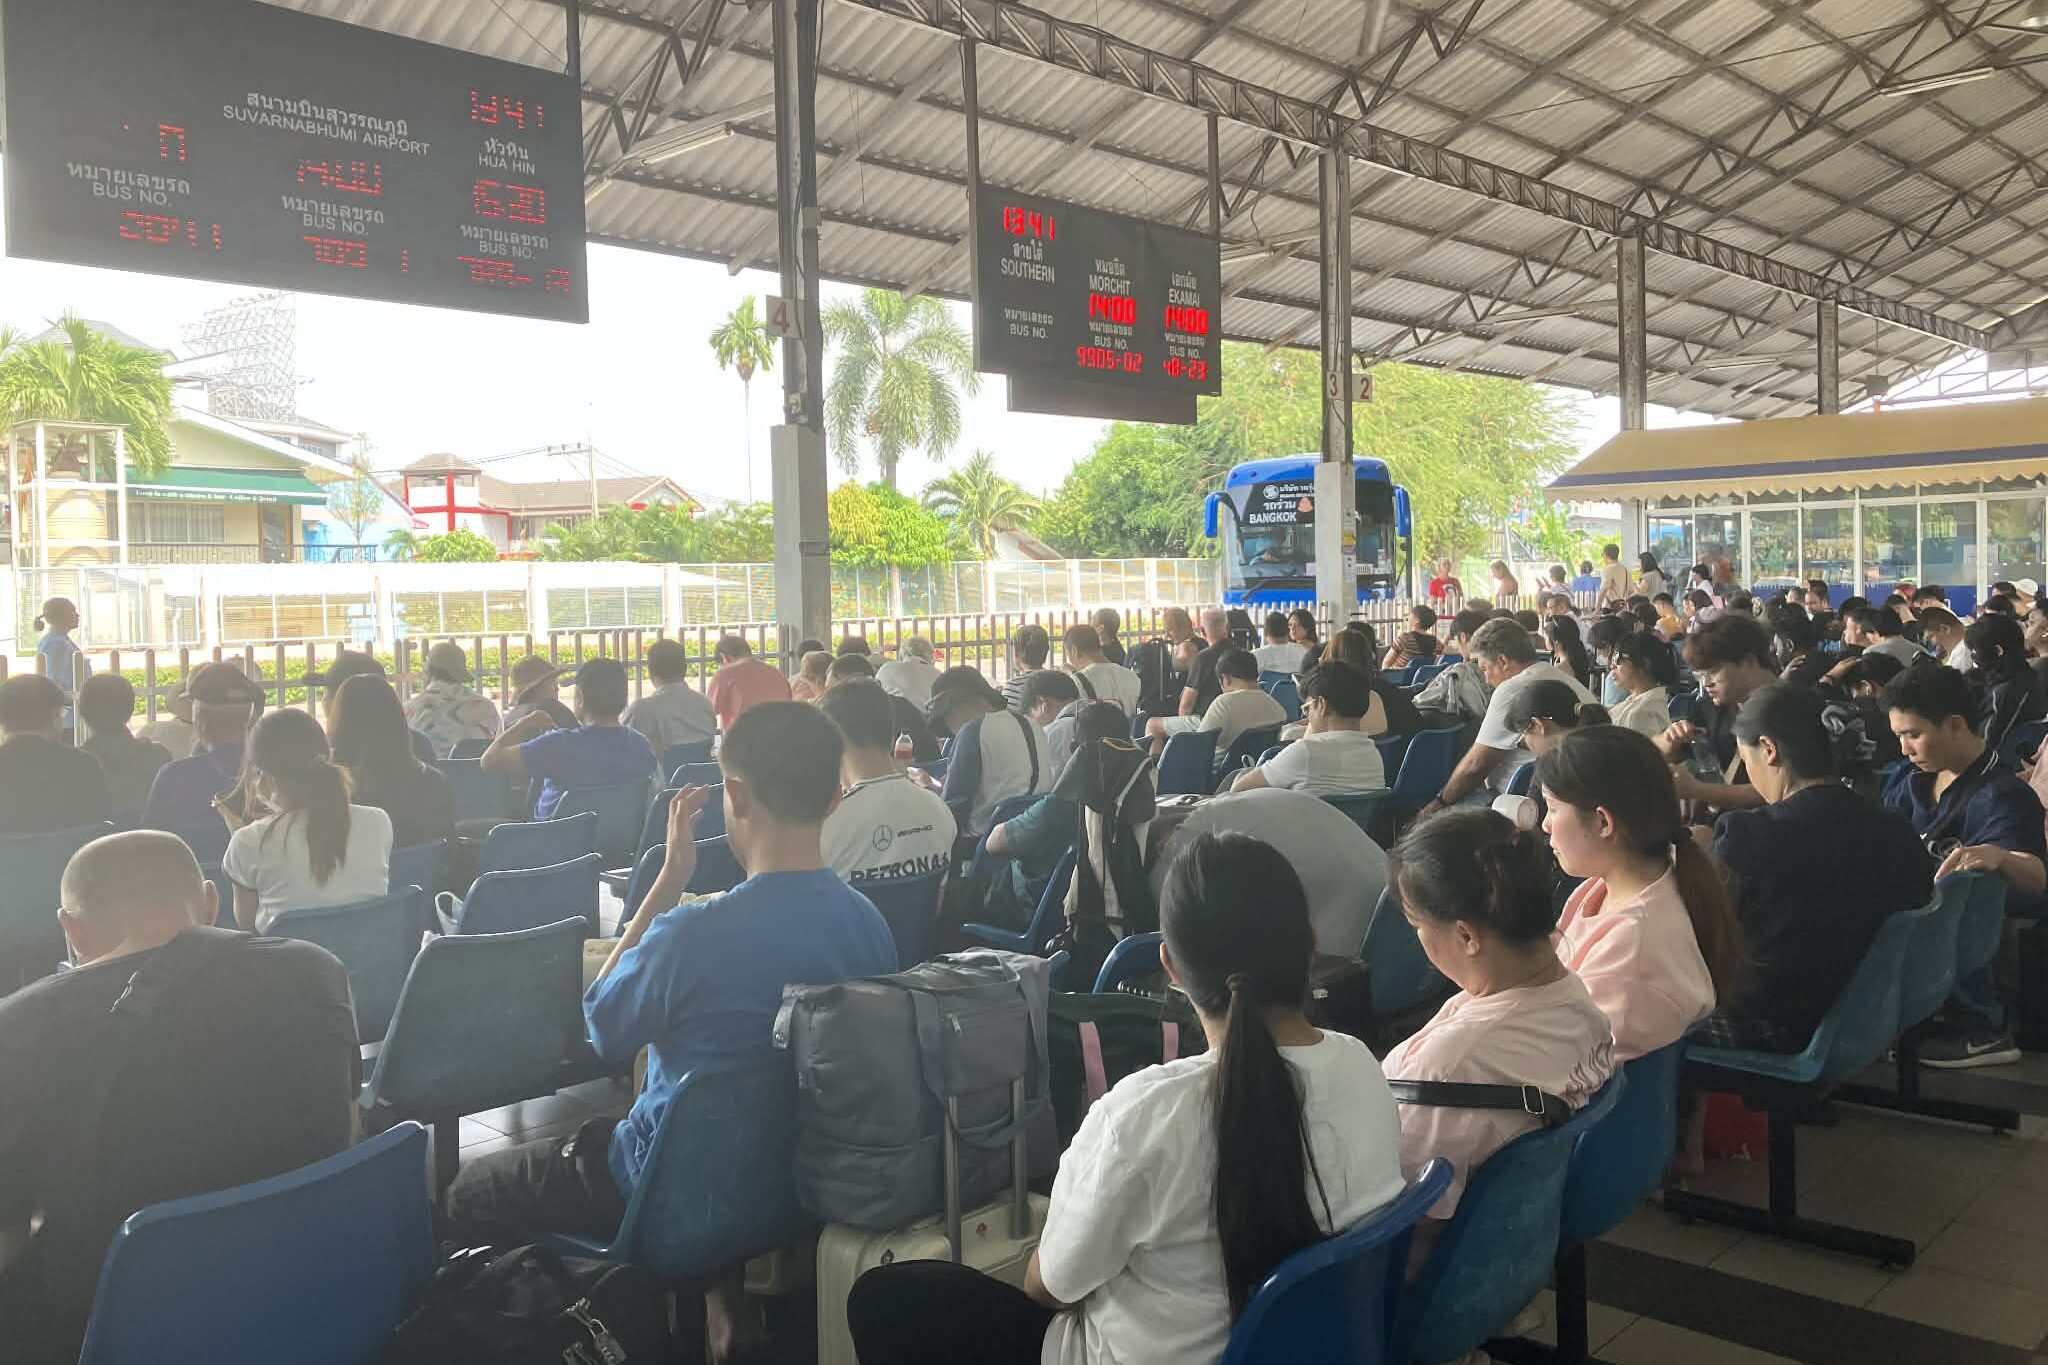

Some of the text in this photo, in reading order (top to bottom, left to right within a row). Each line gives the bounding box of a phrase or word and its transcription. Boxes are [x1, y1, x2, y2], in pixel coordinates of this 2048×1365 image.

[247, 92, 408, 138] สนามบินสุวรรณภูมิ
[223, 105, 430, 155] SUVARNABHUMI AIRPORT
[484, 136, 529, 160] หัวหิน
[479, 155, 536, 175] HUA HIN
[66, 161, 190, 195] หมายเลขรถ
[92, 182, 173, 207] BUS NO.
[281, 196, 385, 224] หมายเลขรถ
[303, 213, 369, 235] BUS NO.
[1003, 206, 1055, 240] 1341
[459, 224, 549, 249] หมายเลขรถ
[479, 240, 536, 260] BUS NO.
[1000, 257, 1055, 283] SOUTHERN
[1089, 275, 1131, 295] MORCHIT
[1168, 288, 1200, 307] EKAMAI
[773, 301, 790, 333] 4
[1010, 323, 1049, 339] BUS NO.
[1094, 335, 1129, 350] BUS NO.
[1169, 346, 1200, 360] BUS NO.
[1330, 373, 1338, 397] 3
[1360, 376, 1370, 399] 2
[1249, 511, 1297, 524] BANGKOK
[851, 851, 949, 880] PETRONAS
